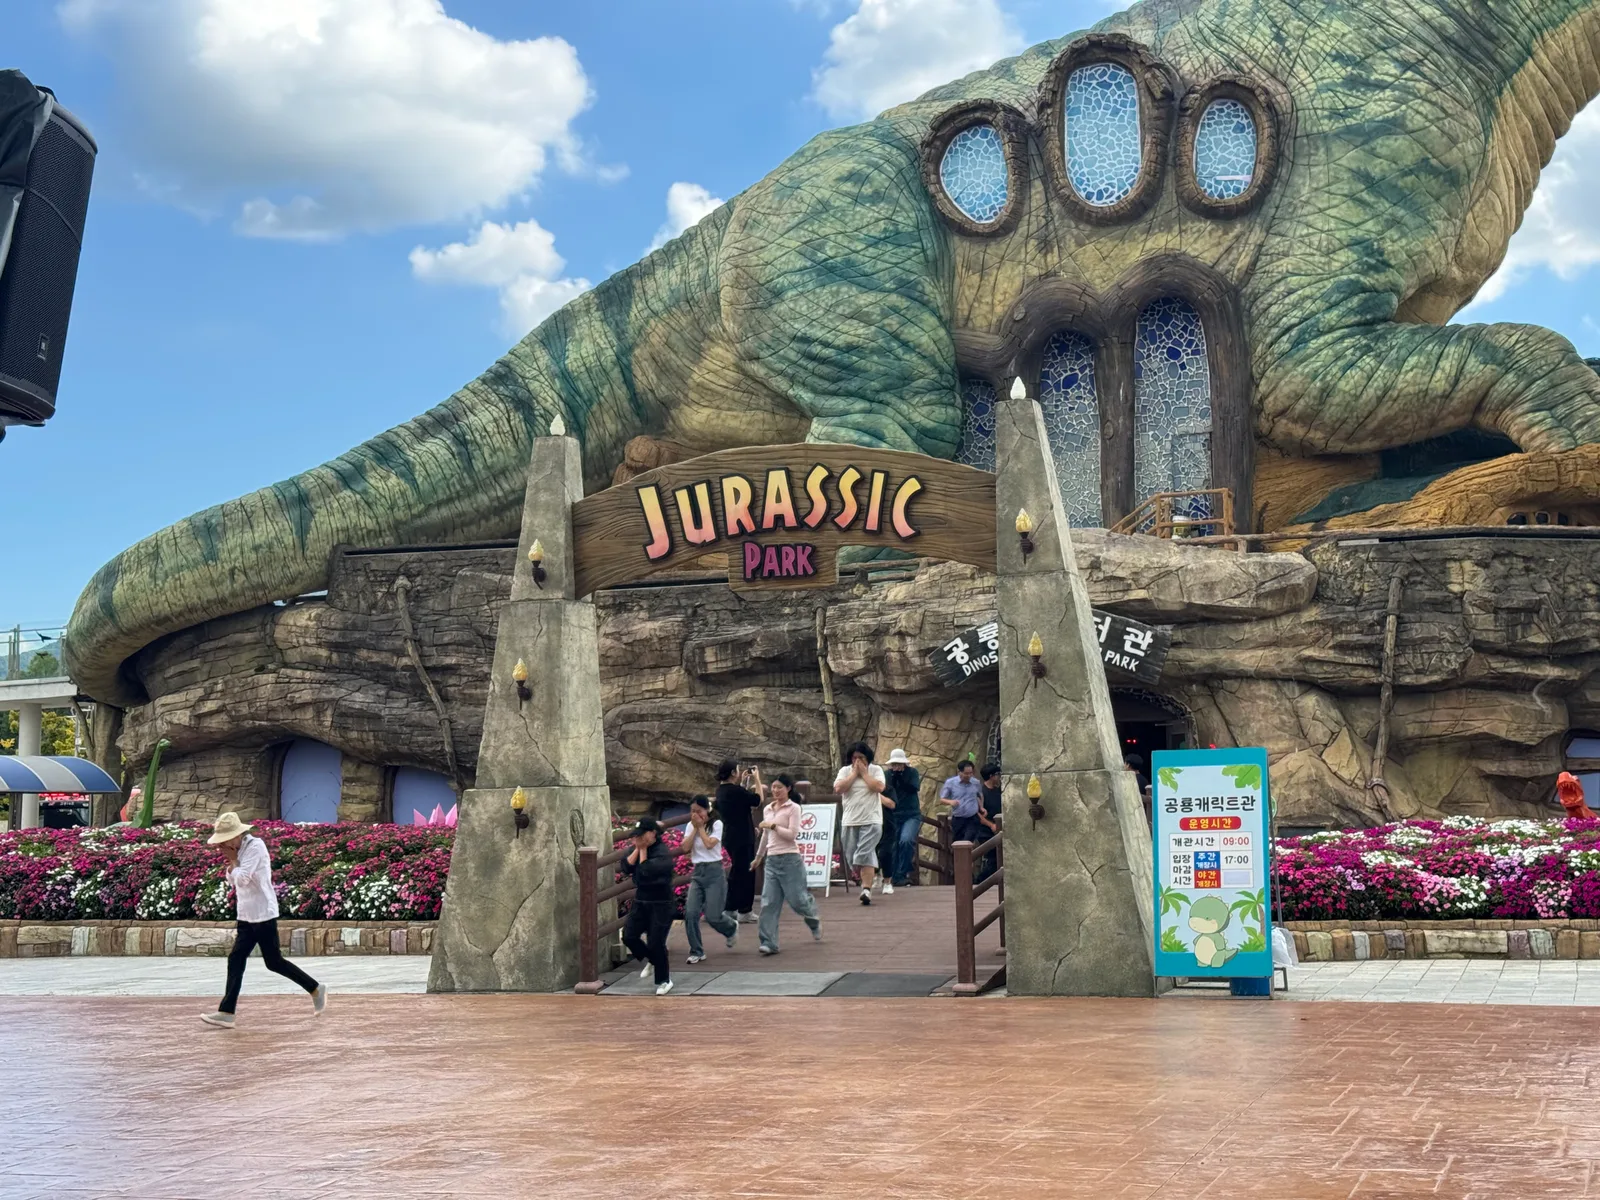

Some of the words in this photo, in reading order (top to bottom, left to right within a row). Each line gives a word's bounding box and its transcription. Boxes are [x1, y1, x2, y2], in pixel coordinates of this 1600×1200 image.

[636, 463, 923, 562] JURASSIC
[743, 541, 817, 582] PARK
[962, 650, 998, 677] DINOS
[1104, 649, 1140, 672] PARK
[1164, 795, 1256, 813] 공룡캐릭트관
[1223, 836, 1249, 846] 09:00
[802, 855, 826, 866] 구역
[1173, 854, 1191, 864] 입장
[1225, 855, 1249, 864] 17:00
[1173, 876, 1191, 886] 시간
